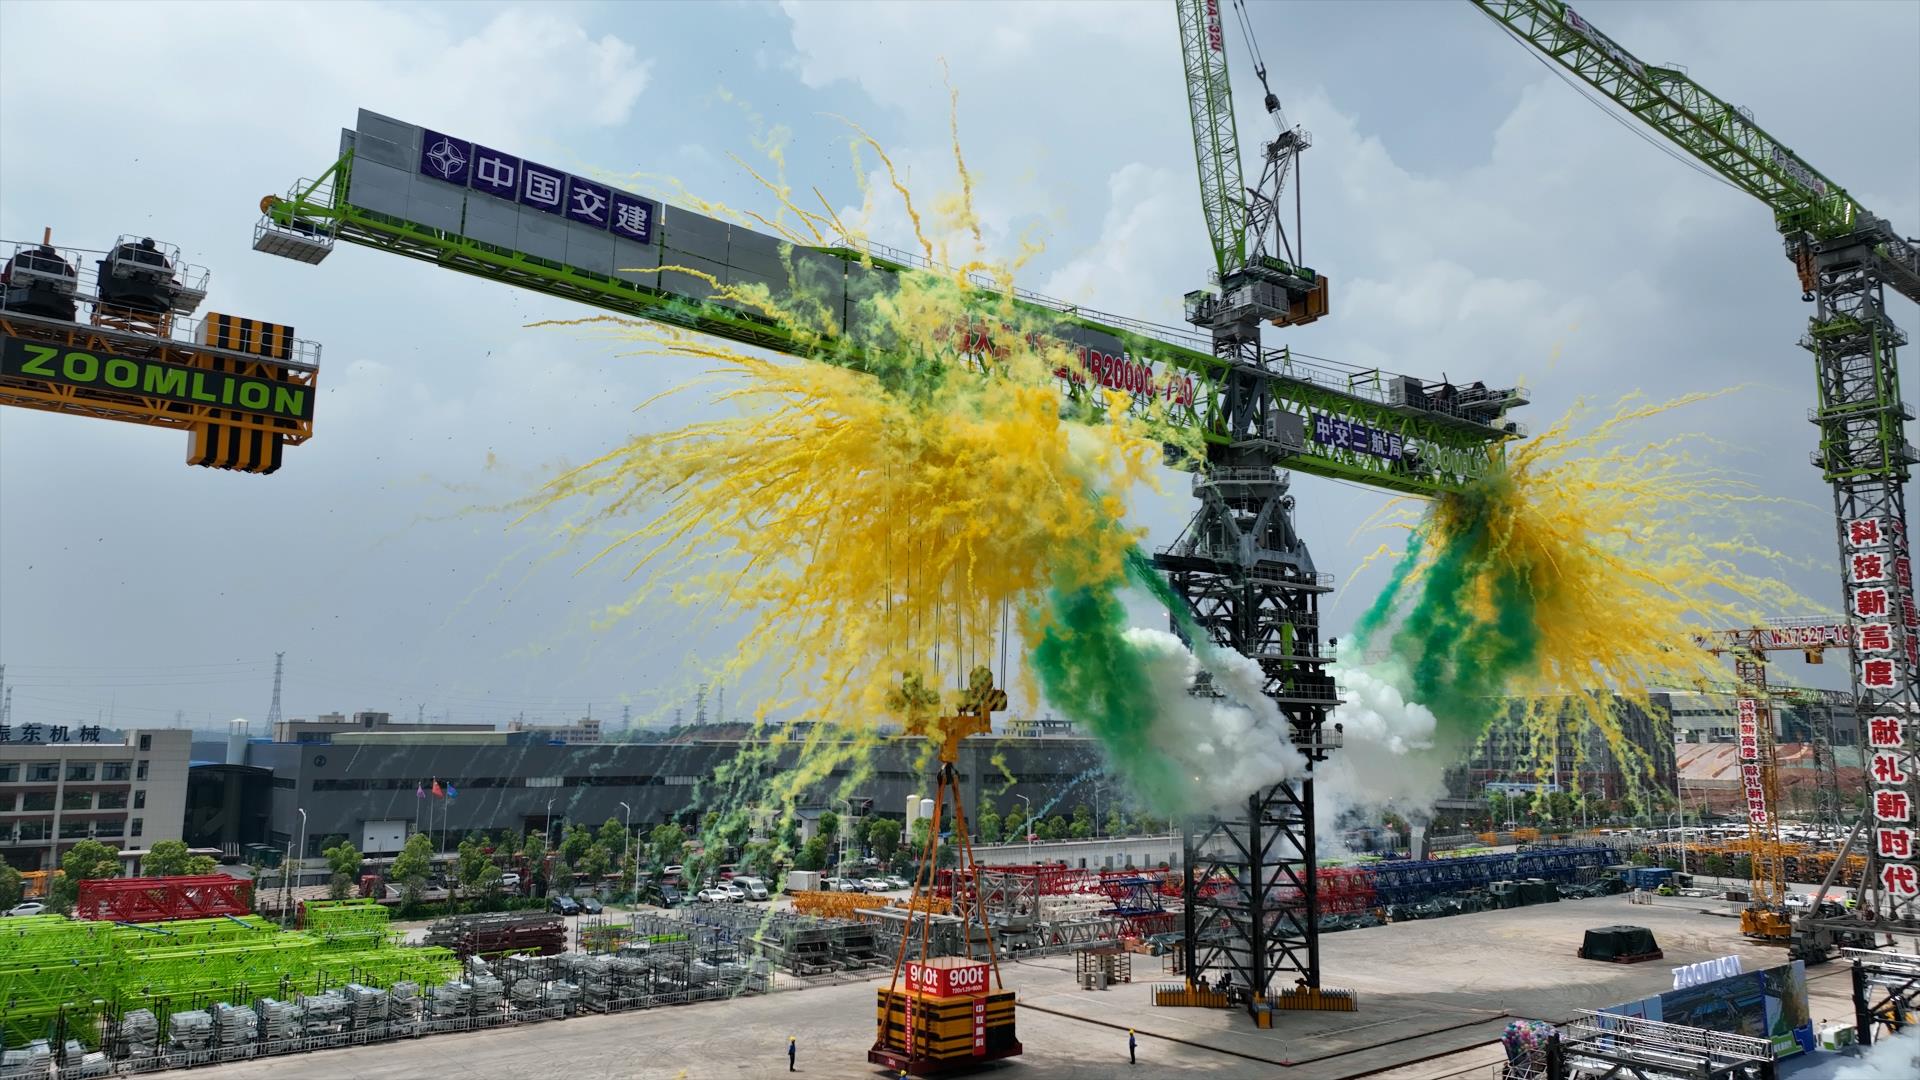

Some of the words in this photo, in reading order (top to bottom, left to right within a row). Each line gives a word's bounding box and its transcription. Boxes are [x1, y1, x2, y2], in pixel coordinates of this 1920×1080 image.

[477, 157, 647, 237] 中国交建
[20, 344, 305, 416] ZOOMLION
[1316, 421, 1403, 460] 中交二航局
[1771, 624, 1859, 645] WA7527-16
[1850, 519, 1894, 687] 科技新高度
[1871, 718, 1916, 894] 献礼新时代
[949, 966, 984, 987] 900t
